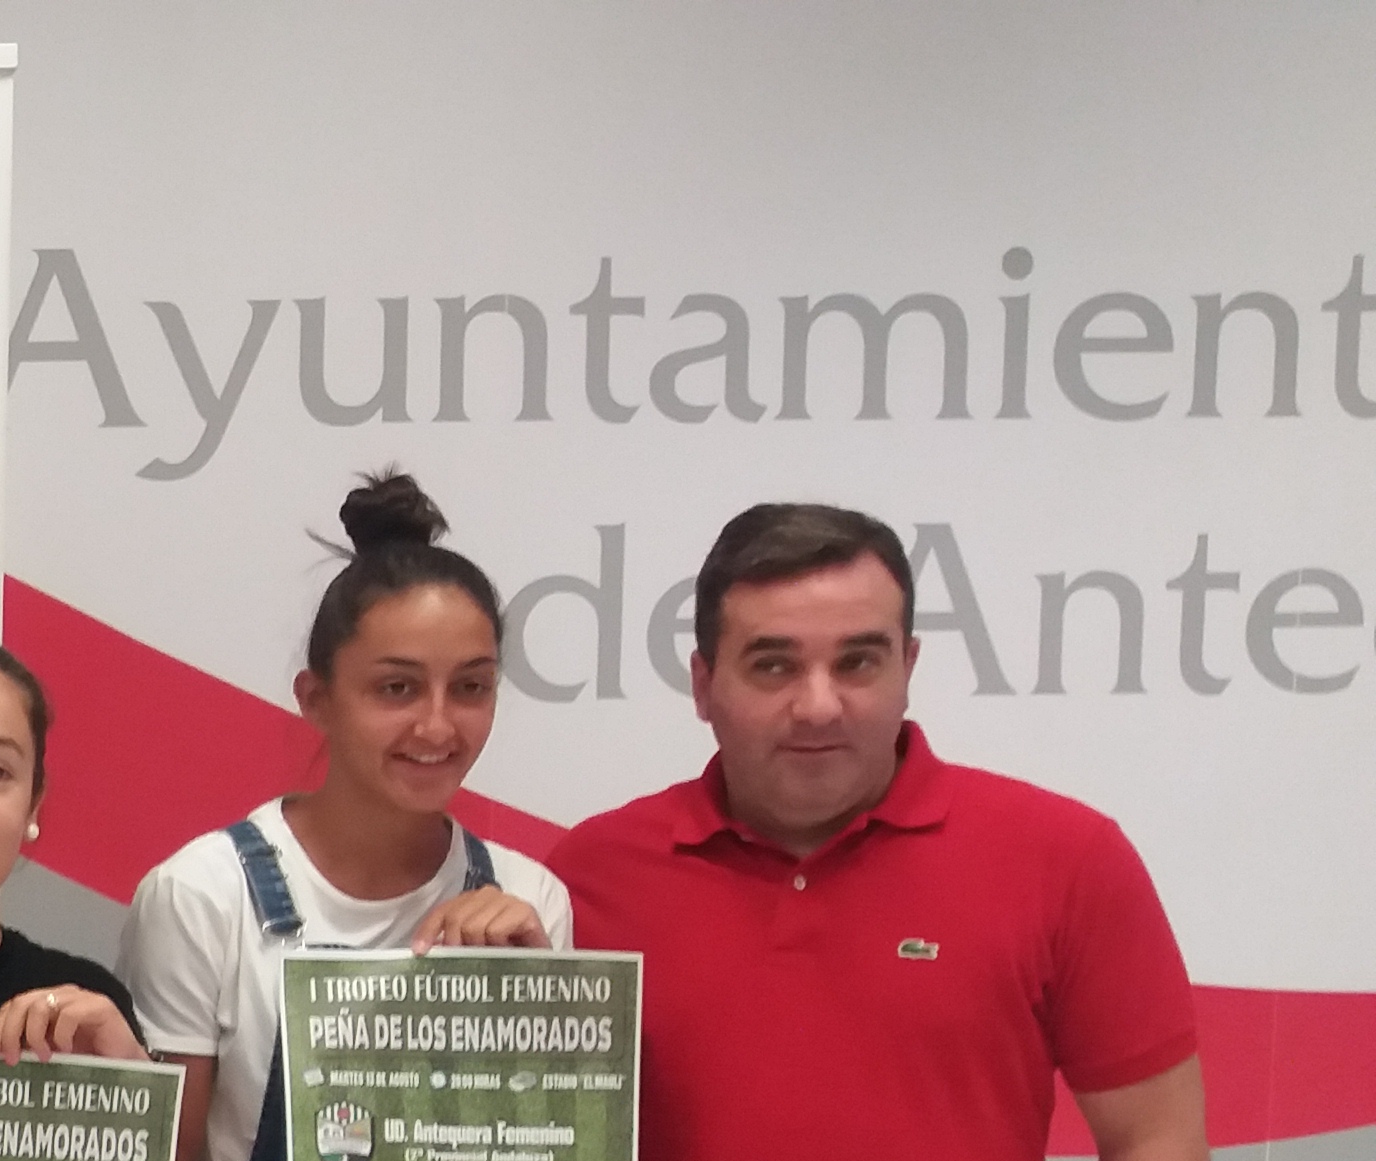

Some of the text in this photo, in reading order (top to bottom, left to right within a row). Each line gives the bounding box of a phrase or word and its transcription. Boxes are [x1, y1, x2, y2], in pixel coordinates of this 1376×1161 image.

[905, 522, 1376, 698] Ante
[309, 974, 611, 1003] I TROFEO FÚTBOL FEMENINO
[308, 1006, 612, 1053] PEÑA DE LOS ENAMORADOS
[42, 1081, 150, 1115] FEMENINO
[384, 1117, 575, 1147] UD. Antequera Femenino
